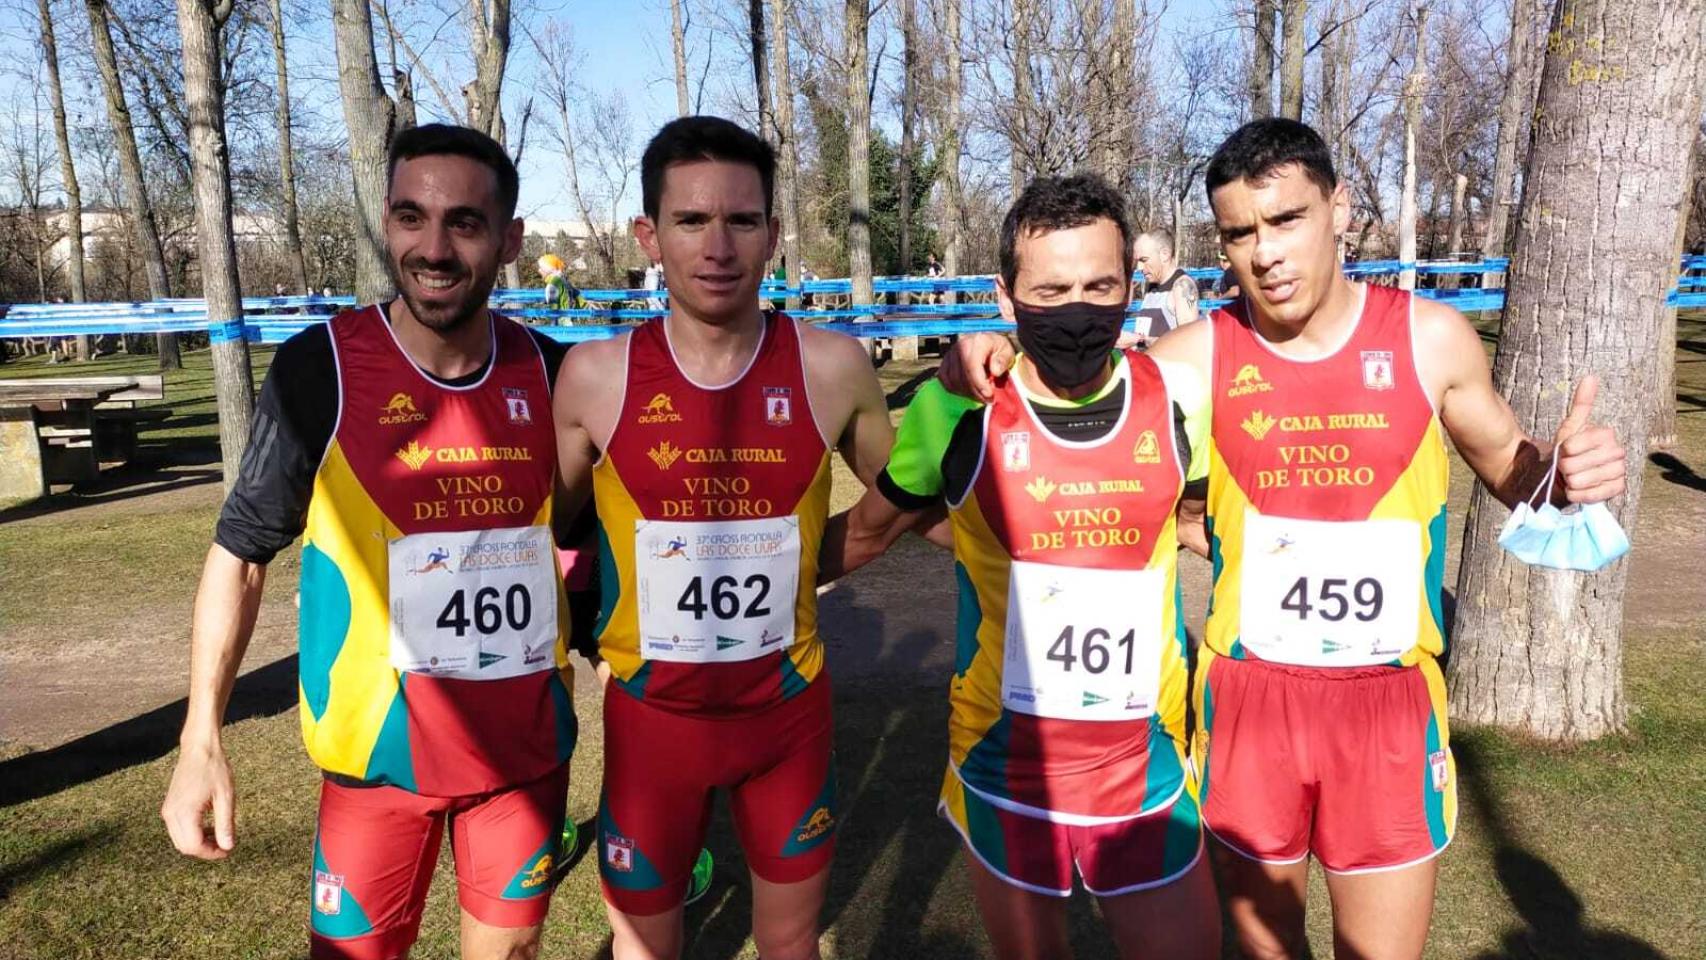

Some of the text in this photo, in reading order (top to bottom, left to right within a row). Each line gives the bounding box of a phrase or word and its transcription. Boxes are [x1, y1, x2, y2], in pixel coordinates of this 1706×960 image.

[1280, 414, 1389, 432] CAJA RURAL
[436, 447, 532, 462] CAJA RURAL
[685, 449, 786, 463] CAJA RURAL
[1279, 444, 1349, 464] VINO
[436, 475, 502, 496] VINO
[683, 476, 750, 496] VINO
[1059, 480, 1144, 496] CAJA RURAL
[1257, 467, 1375, 489] DE TORO
[413, 496, 524, 520] DE TORO
[662, 499, 772, 517] DE TORO
[1054, 507, 1121, 528] VINO
[1031, 528, 1140, 551] DE TORO
[677, 574, 771, 620] 462
[1281, 576, 1384, 622] 459
[436, 583, 532, 637] 460
[1046, 625, 1135, 675] 461
